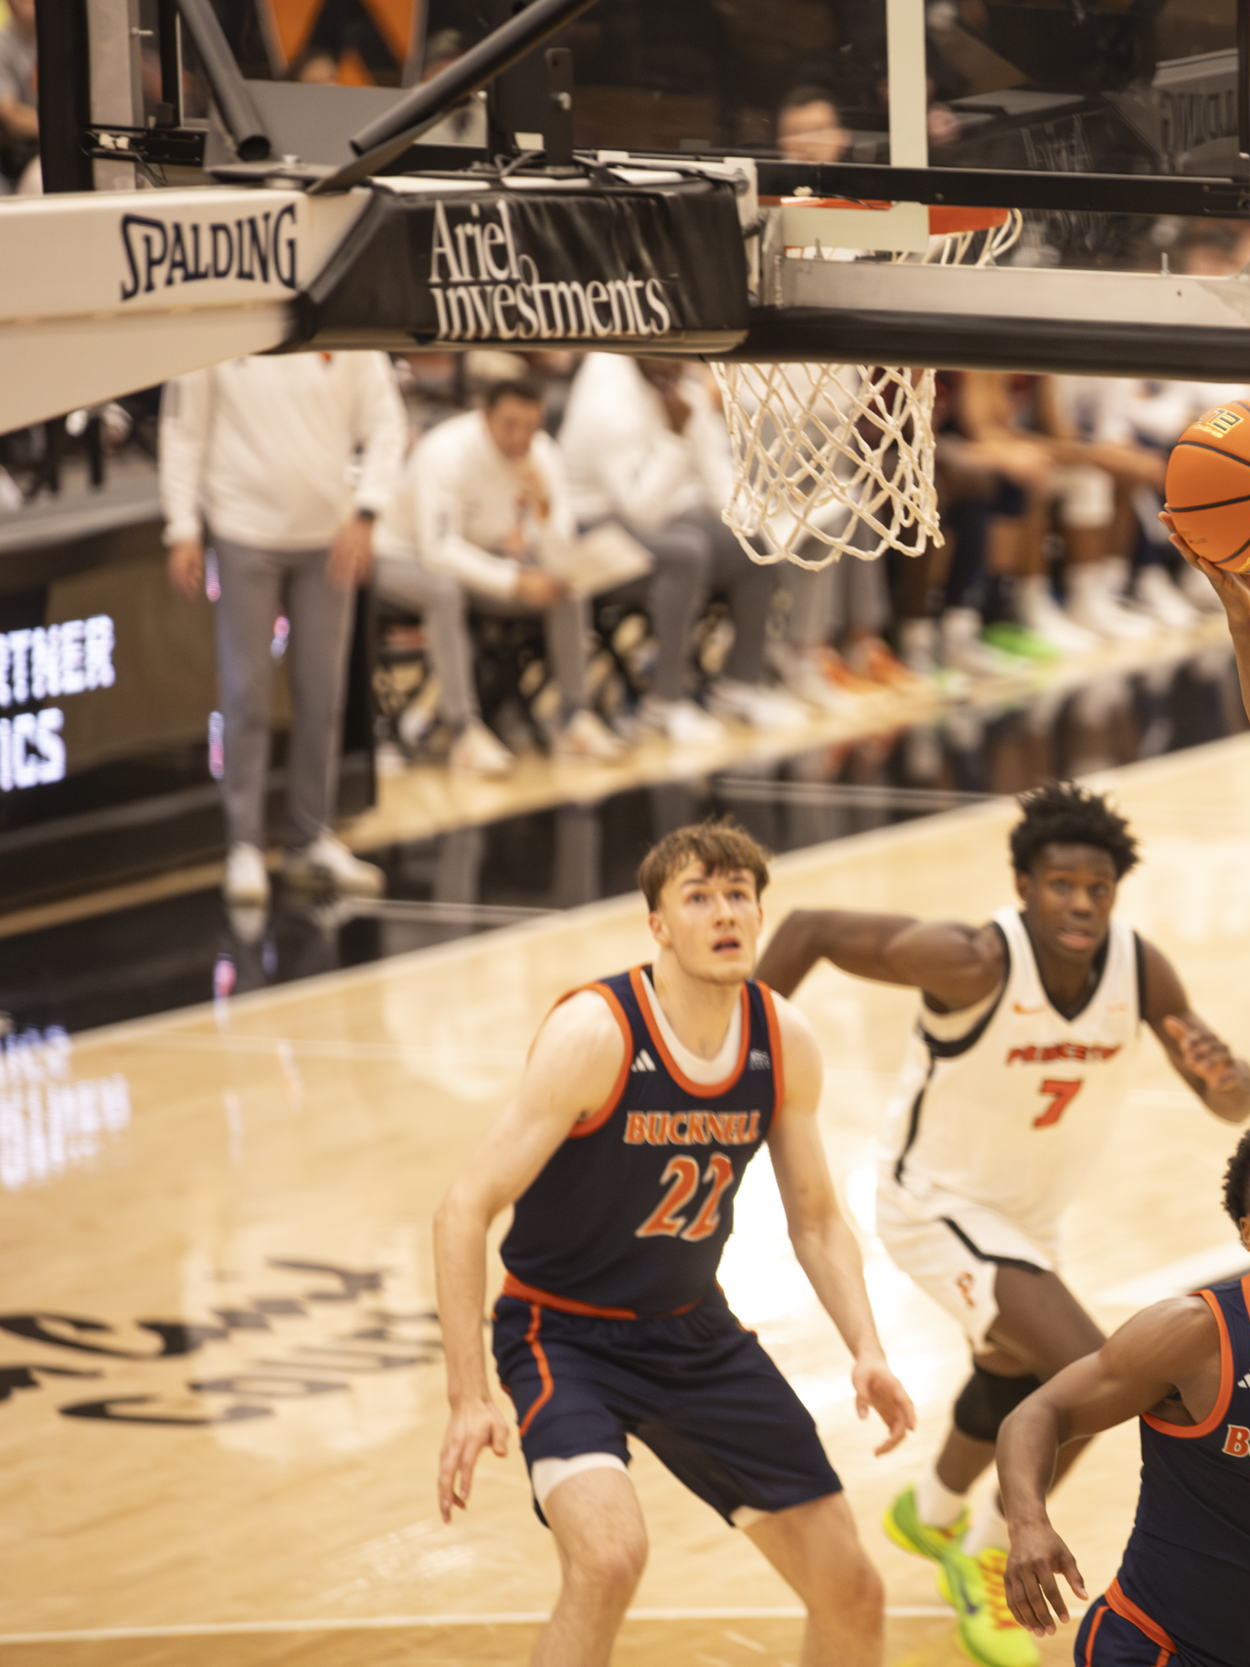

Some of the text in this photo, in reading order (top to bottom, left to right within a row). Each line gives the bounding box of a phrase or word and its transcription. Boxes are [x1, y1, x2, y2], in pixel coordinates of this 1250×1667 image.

[120, 202, 297, 302] SPALDING
[428, 199, 521, 284] Ariel
[428, 256, 671, 340] investments
[623, 1110, 761, 1146] BUCKNELL
[1032, 1078, 1084, 1130] 7
